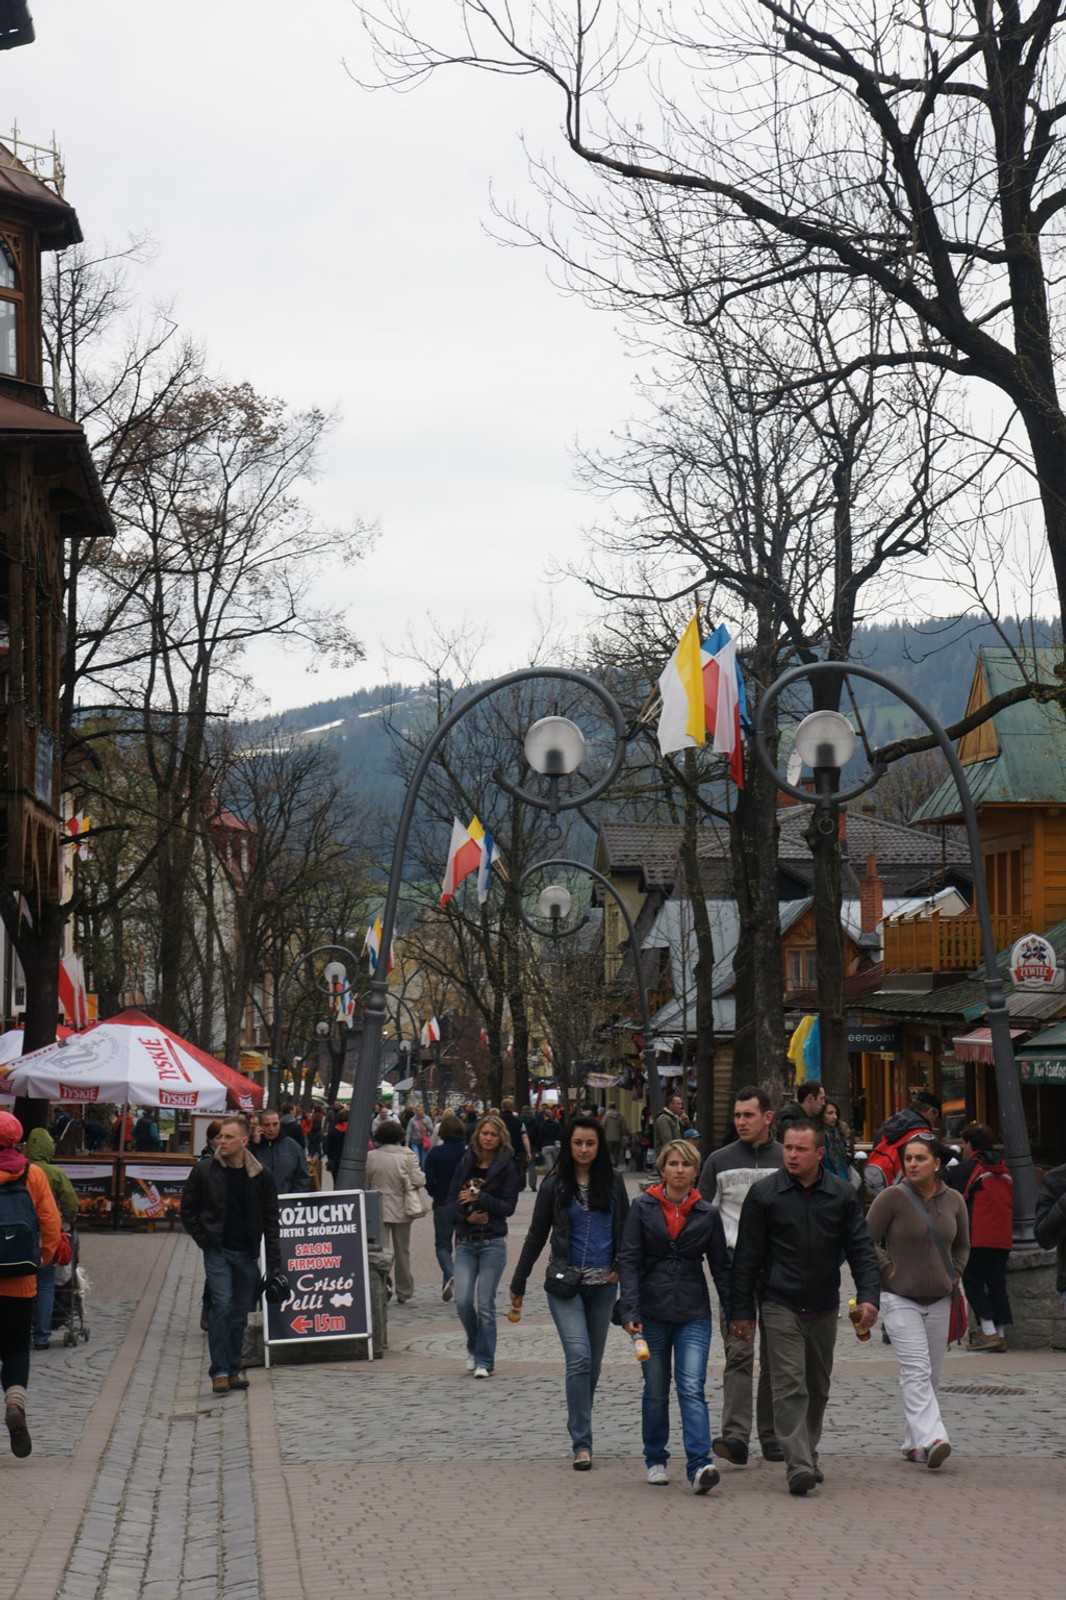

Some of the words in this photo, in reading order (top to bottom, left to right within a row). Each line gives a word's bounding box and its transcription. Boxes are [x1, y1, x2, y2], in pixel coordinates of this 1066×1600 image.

[138, 1038, 181, 1081] TYSKIE
[62, 1086, 97, 1100] TYSKIE
[161, 1092, 196, 1105] TYSKIE
[307, 1224, 357, 1236] SKÓRZANE
[295, 1242, 332, 1256] SALON
[288, 1256, 342, 1271] FIRMOWY
[297, 1274, 354, 1292] Cristo
[314, 1313, 346, 1332] 15m
